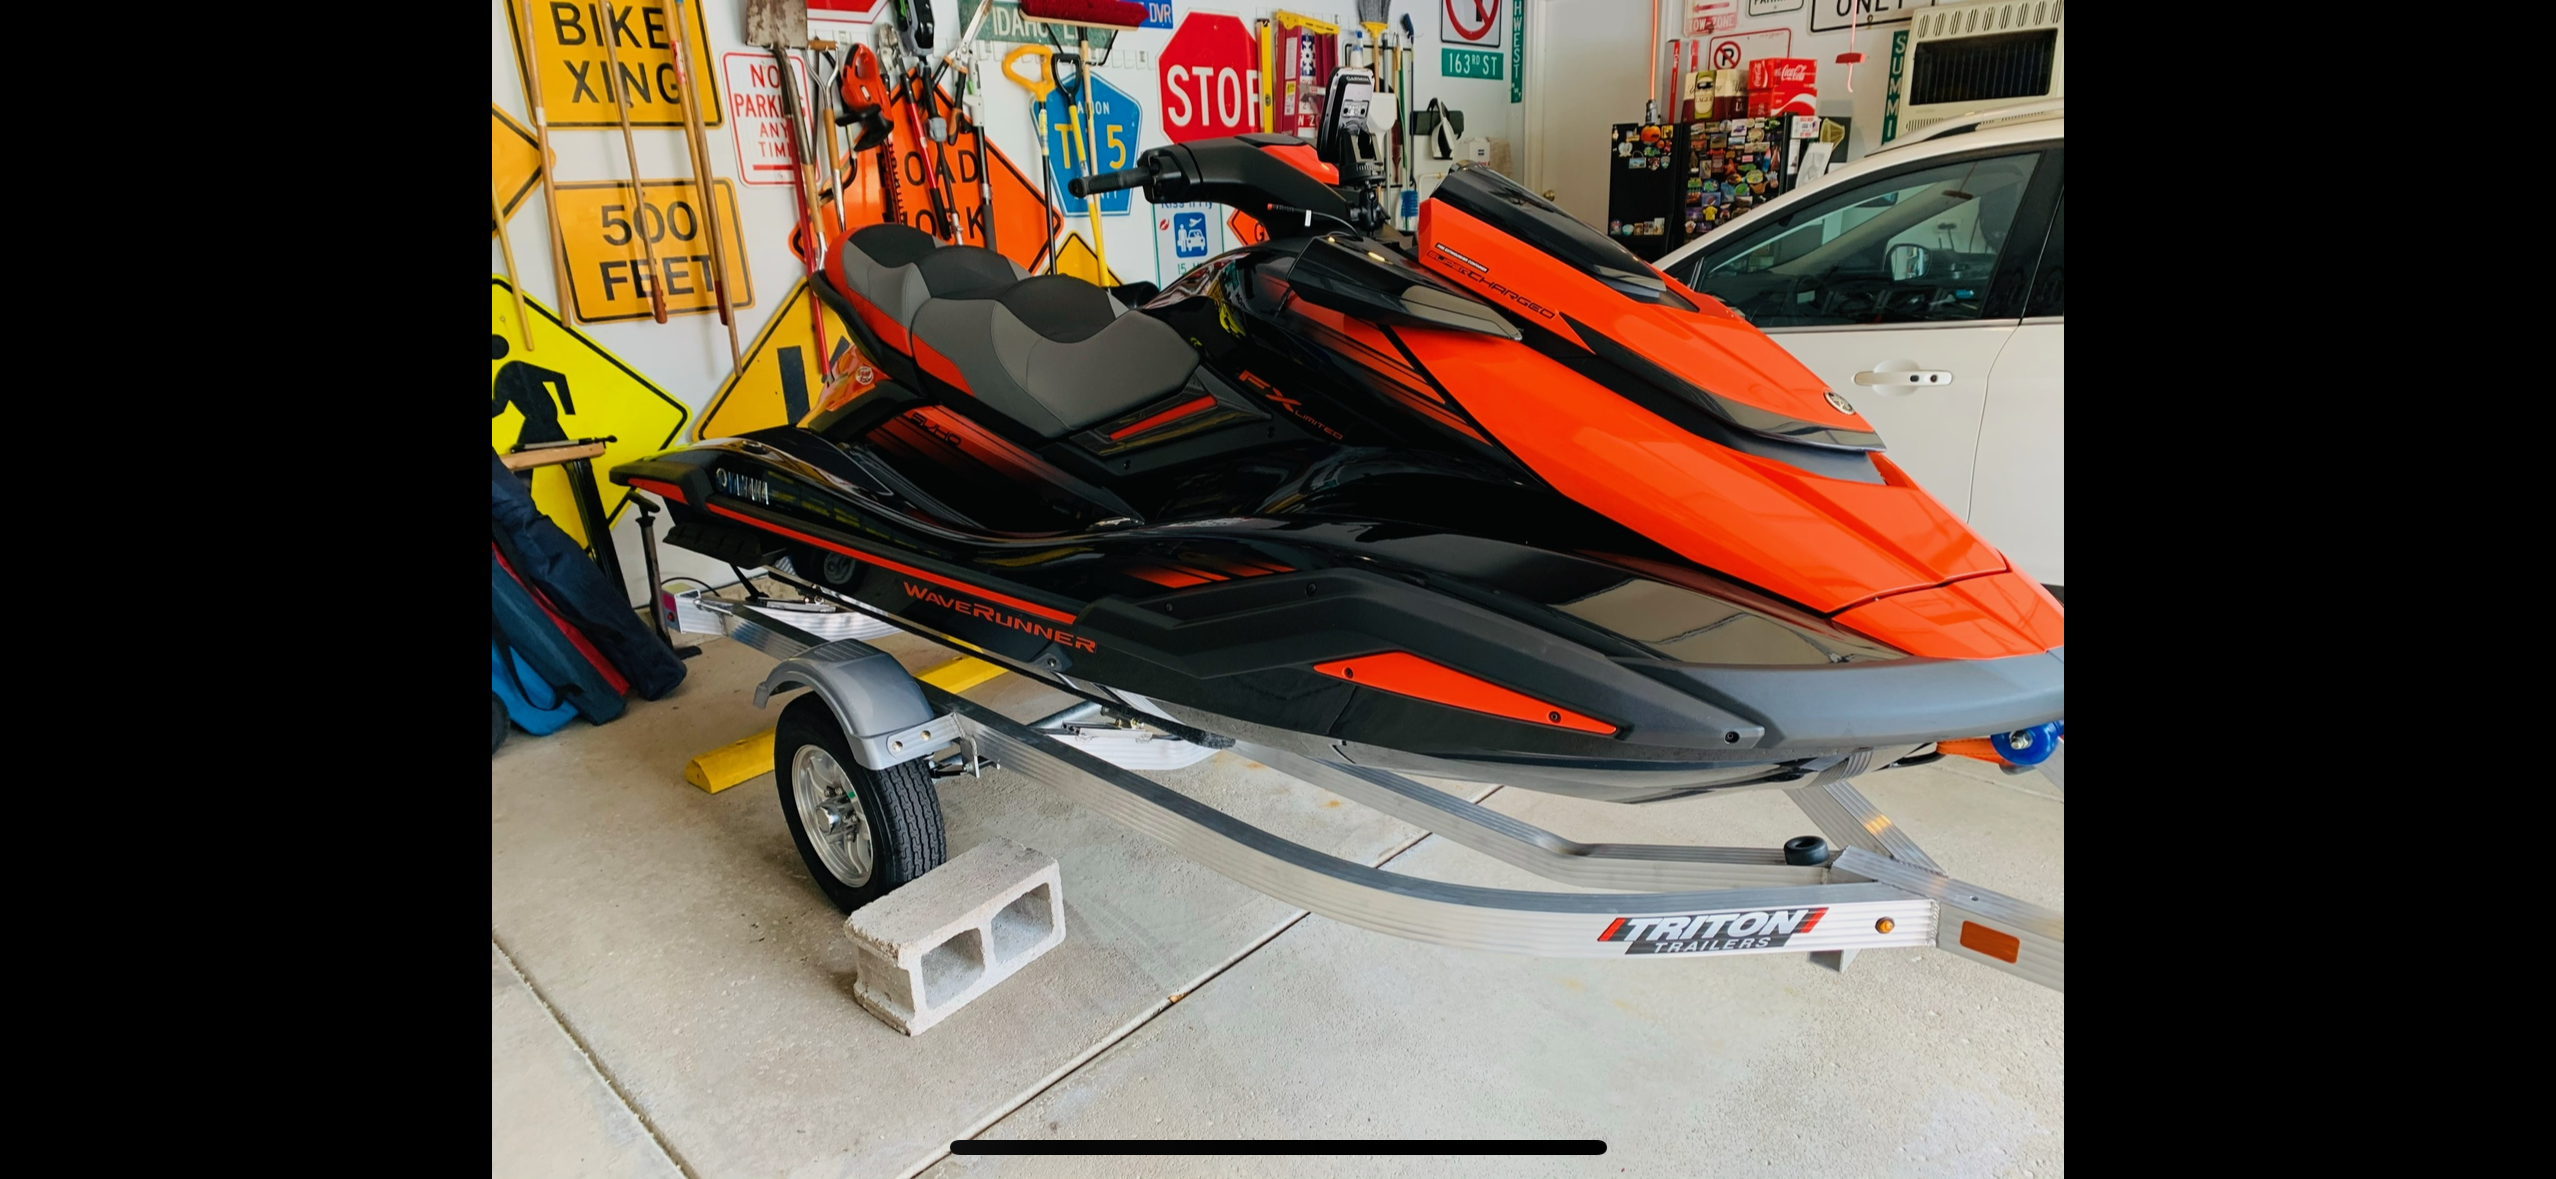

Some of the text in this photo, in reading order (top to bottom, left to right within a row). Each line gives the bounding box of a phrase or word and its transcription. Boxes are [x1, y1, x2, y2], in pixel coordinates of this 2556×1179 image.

[554, 1, 669, 50] BIKE
[563, 59, 682, 105] XING
[750, 63, 781, 89] NO
[1482, 55, 1497, 76] ST
[759, 121, 788, 138] ANY
[601, 200, 699, 246] 500
[599, 254, 716, 302] FEET
[1427, 250, 1556, 320] SUPERCHARGED
[1238, 370, 1302, 413] FX
[1294, 409, 1344, 440] LIMITED
[1623, 909, 1808, 943] TRITON
[1654, 936, 1772, 954] TRAILERS
